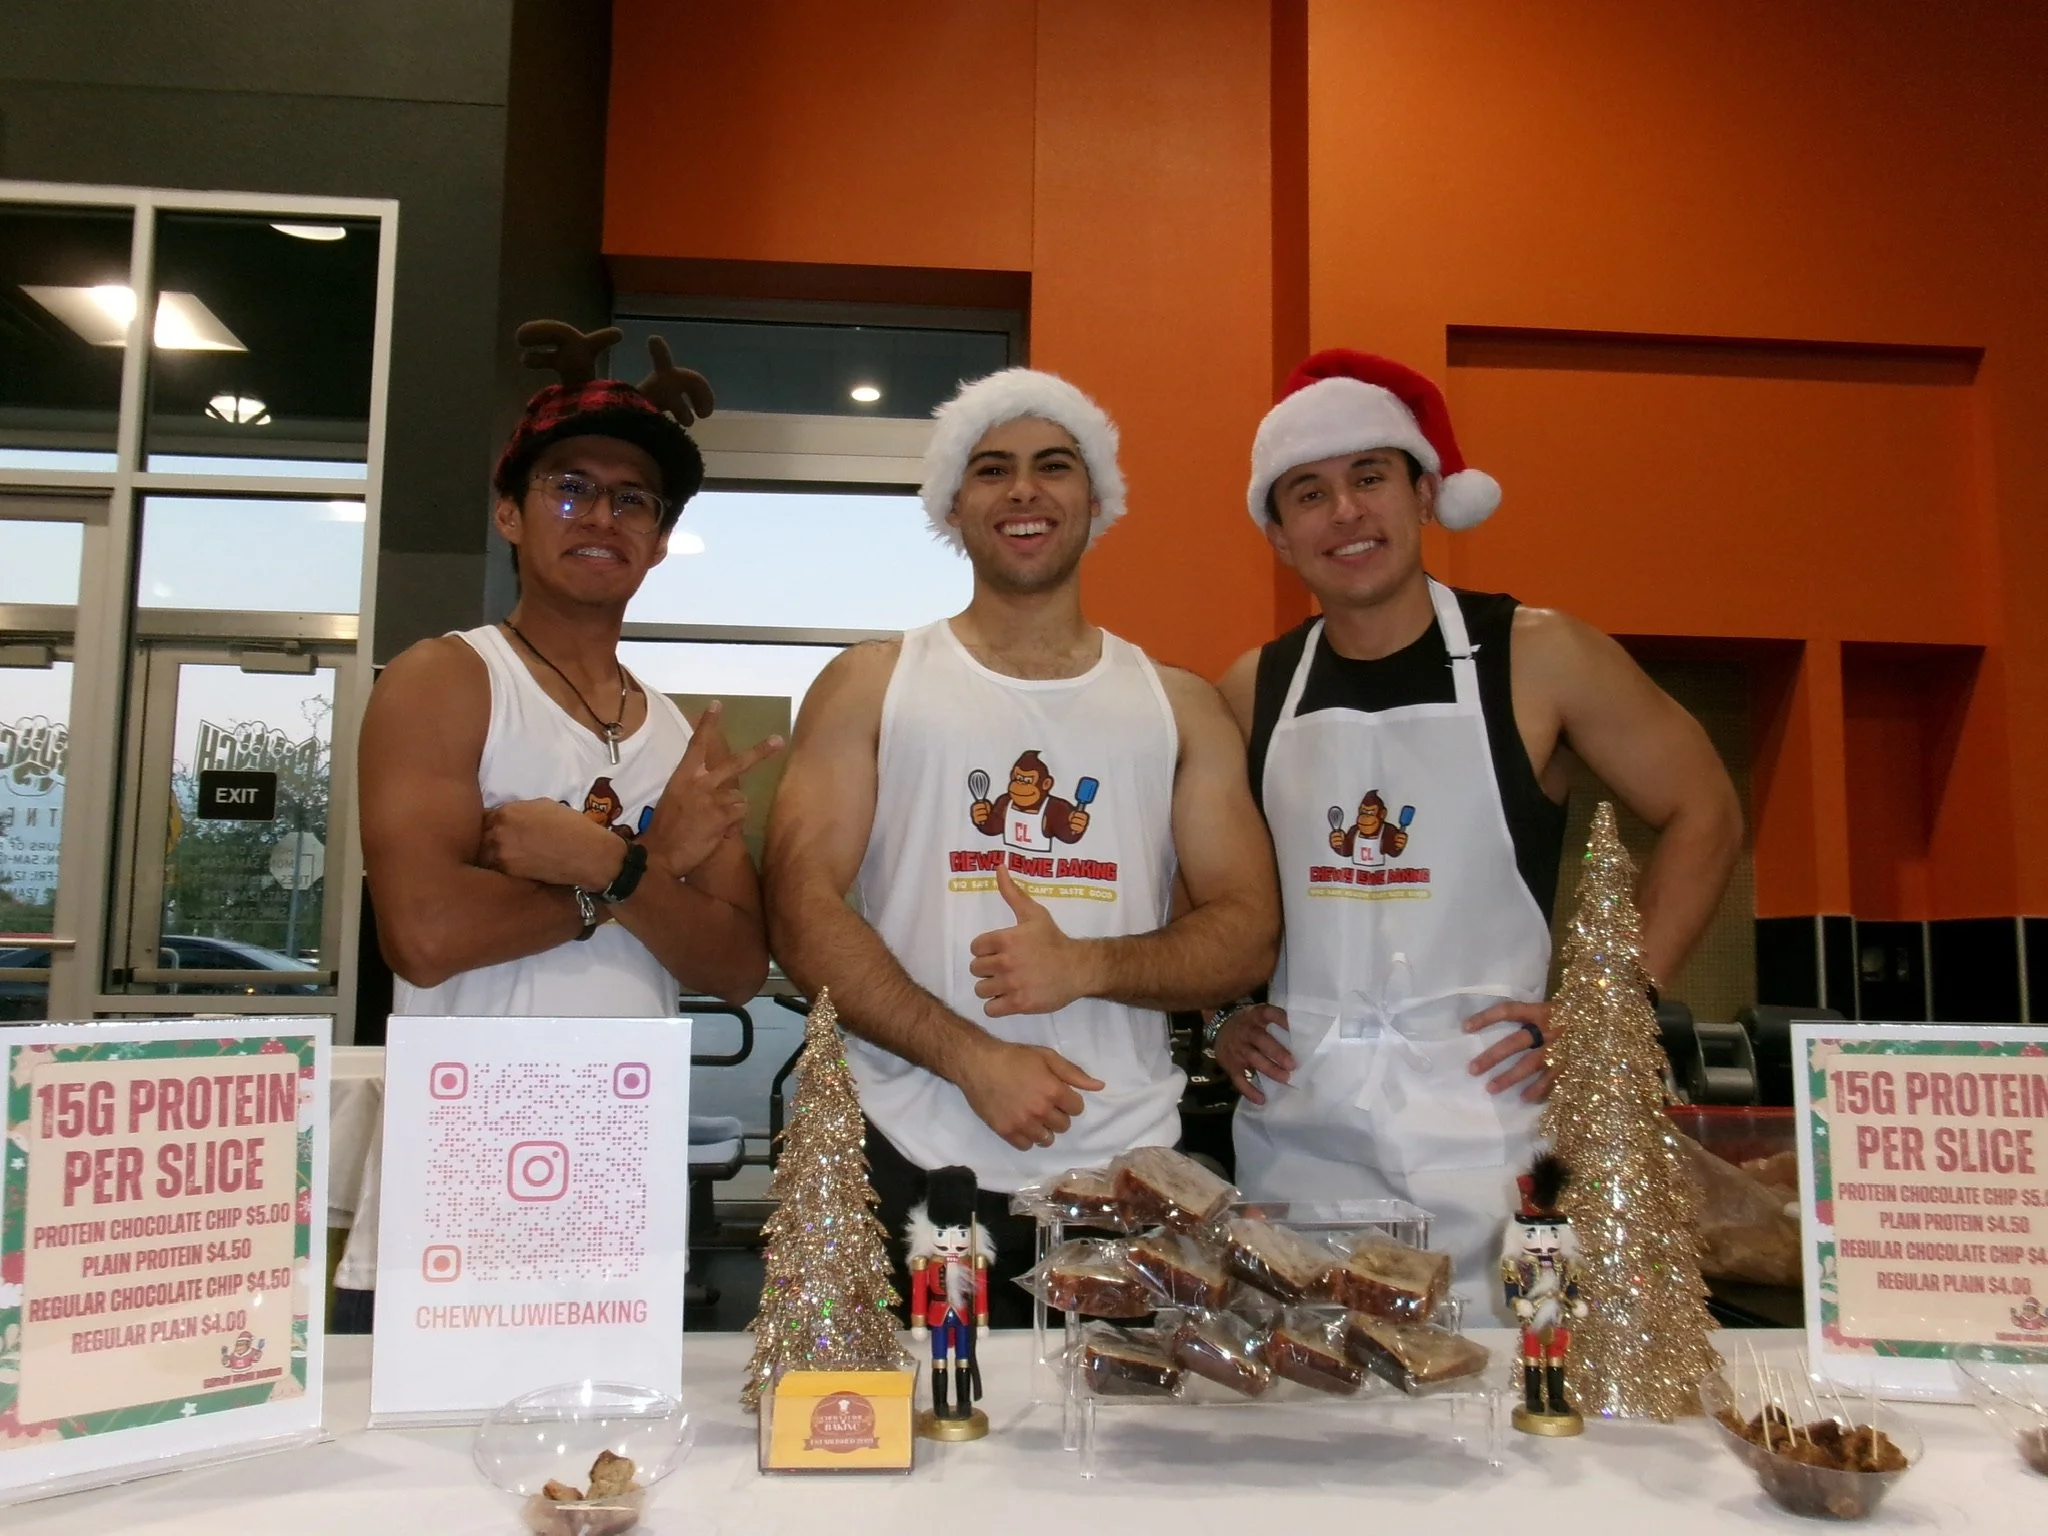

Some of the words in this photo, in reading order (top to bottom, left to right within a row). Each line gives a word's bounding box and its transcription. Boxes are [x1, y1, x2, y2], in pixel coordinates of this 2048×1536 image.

[215, 787, 259, 804] EXIT
[1015, 821, 1032, 843] CL
[1360, 847, 1374, 861] CL
[1056, 858, 1118, 882] BAKING
[36, 1080, 116, 1140] 15G
[128, 1072, 297, 1134] PROTEIN
[1830, 1070, 1896, 1115] 15G
[1856, 1125, 1925, 1172] PER
[1934, 1127, 2036, 1174] SLICE
[62, 1146, 145, 1207] PER
[156, 1137, 266, 1200] SLICE
[1838, 1182, 1897, 1203] PROTEIN
[1900, 1184, 1980, 1206] CHOCOLATE
[1983, 1187, 2018, 1206] CHIP
[2021, 1188, 2048, 1208] $5.
[33, 1220, 106, 1250] PROTEIN
[110, 1211, 202, 1242] CHOCOLATE
[205, 1206, 241, 1231] CHIP
[245, 1202, 290, 1226] $5.00
[1879, 1211, 1921, 1231] PLAIN
[1924, 1213, 1984, 1233] PROTEIN
[1987, 1215, 2030, 1235] $4.50
[82, 1253, 131, 1279] PLAIN
[135, 1243, 202, 1275] PROTEIN
[205, 1238, 252, 1263] $4.50
[1840, 1239, 1902, 1259] REGULAR
[1906, 1242, 1986, 1263] CHOCOLATE
[1989, 1244, 2024, 1265] CHIP
[28, 1290, 107, 1323] REGULAR
[110, 1279, 203, 1314] CHOCOLATE
[206, 1271, 243, 1299] CHIP
[247, 1266, 291, 1292] $4.50
[1877, 1271, 1940, 1292] REGULAR
[1943, 1273, 1985, 1294] PLAIN
[1988, 1275, 2031, 1295] $4.00
[416, 1299, 648, 1329] CHEWYLUWIEBAKING
[71, 1325, 147, 1355] REGULAR
[150, 1314, 197, 1345] PLAIN
[201, 1309, 247, 1335] $4.00
